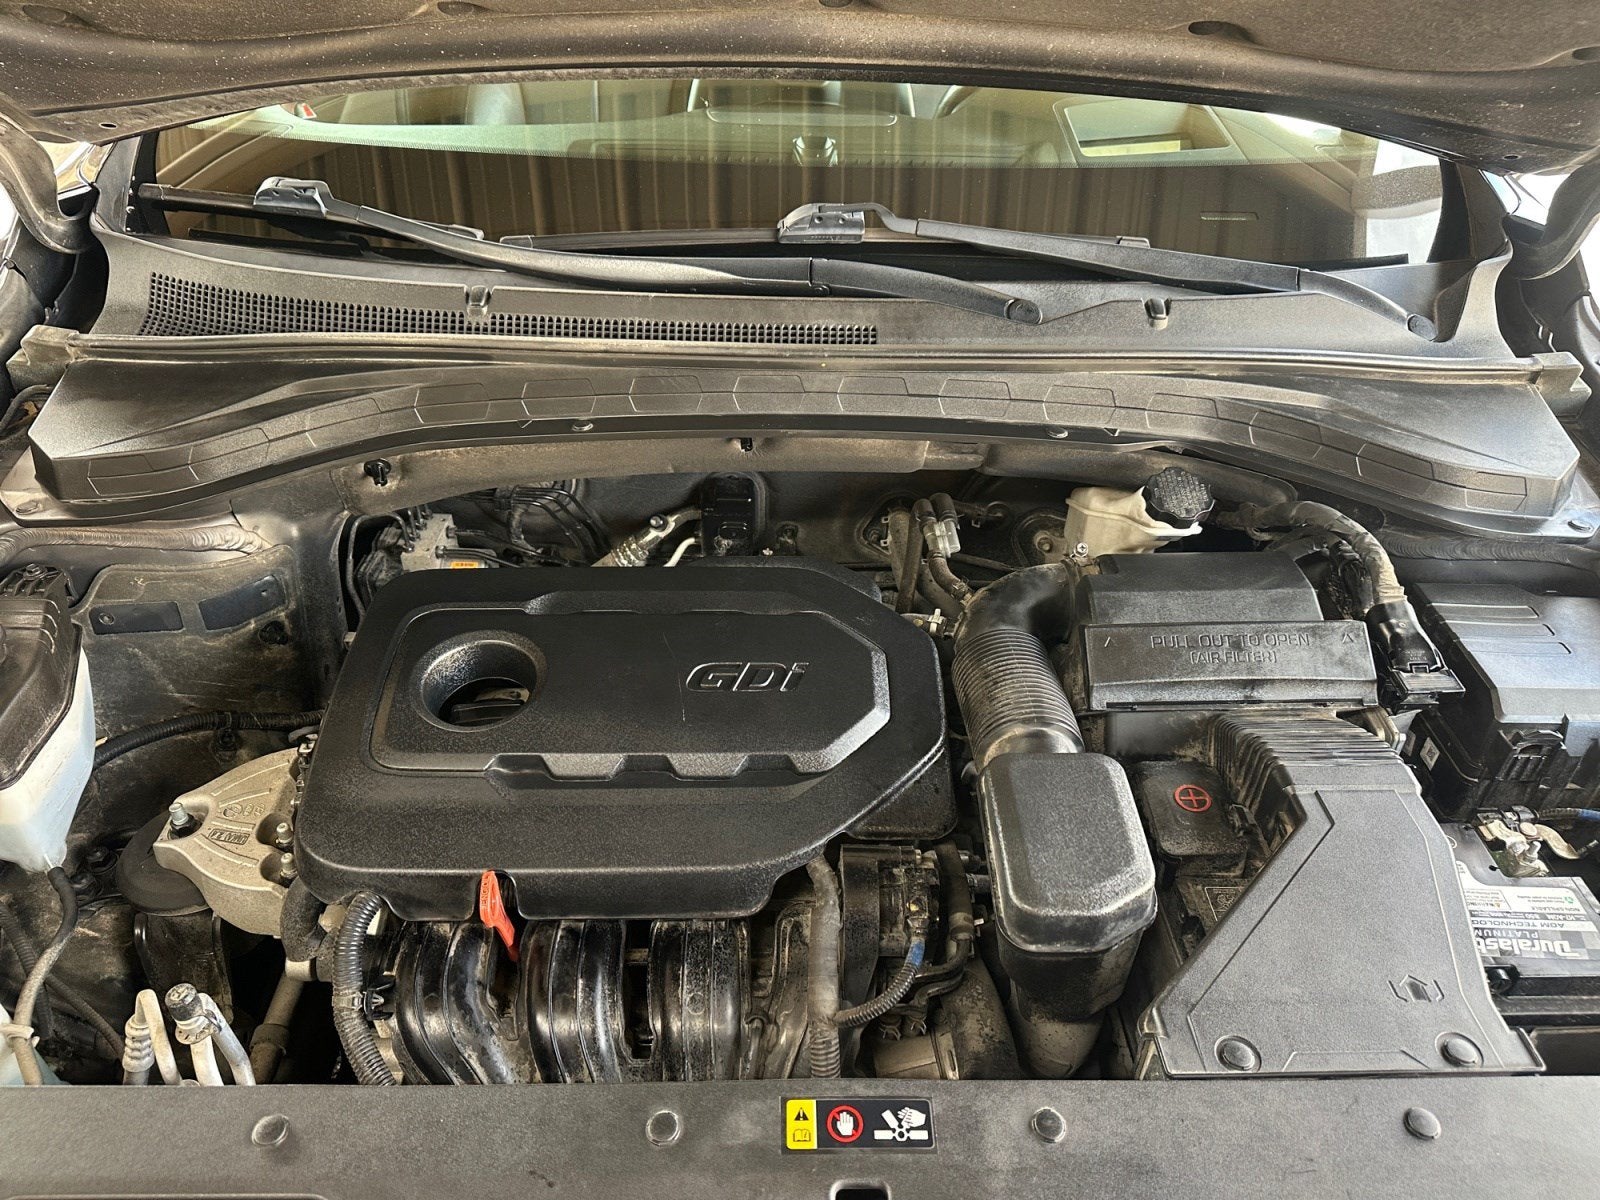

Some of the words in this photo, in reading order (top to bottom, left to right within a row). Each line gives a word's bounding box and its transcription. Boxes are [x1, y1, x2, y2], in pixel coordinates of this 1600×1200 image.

[1150, 634, 1194, 649] PULL
[1199, 634, 1233, 648] OUT
[1239, 633, 1260, 647] TO
[1264, 632, 1310, 646] OPEN
[1471, 919, 1538, 927] TECHNOLOG
[1474, 929, 1539, 938] PLATINUM
[1475, 937, 1581, 957] Duralast
